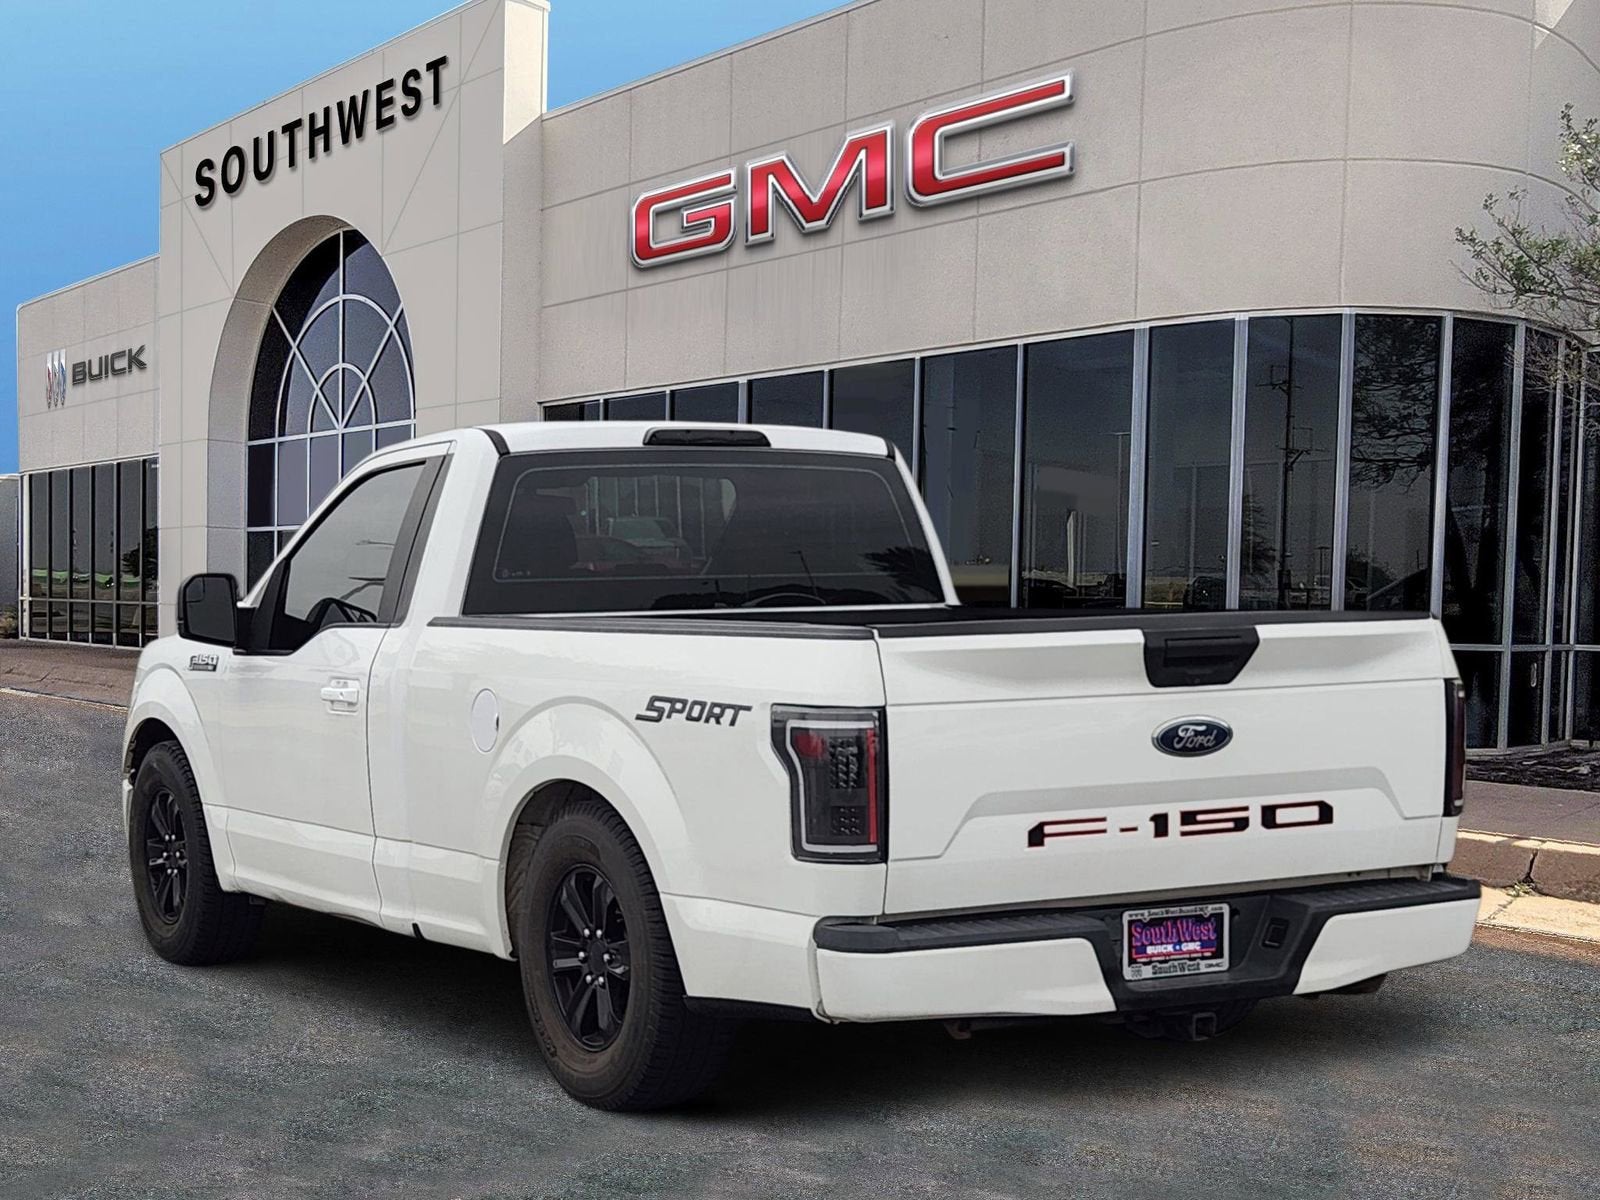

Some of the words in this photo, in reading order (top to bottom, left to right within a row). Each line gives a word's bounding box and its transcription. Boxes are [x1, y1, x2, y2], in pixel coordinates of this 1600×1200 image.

[194, 55, 449, 207] SOUTHWEST
[629, 69, 1076, 269] GMC
[72, 344, 148, 386] BUICK
[635, 695, 752, 727] SPORT
[1173, 724, 1216, 749] Ford
[1027, 800, 1334, 848] F-150
